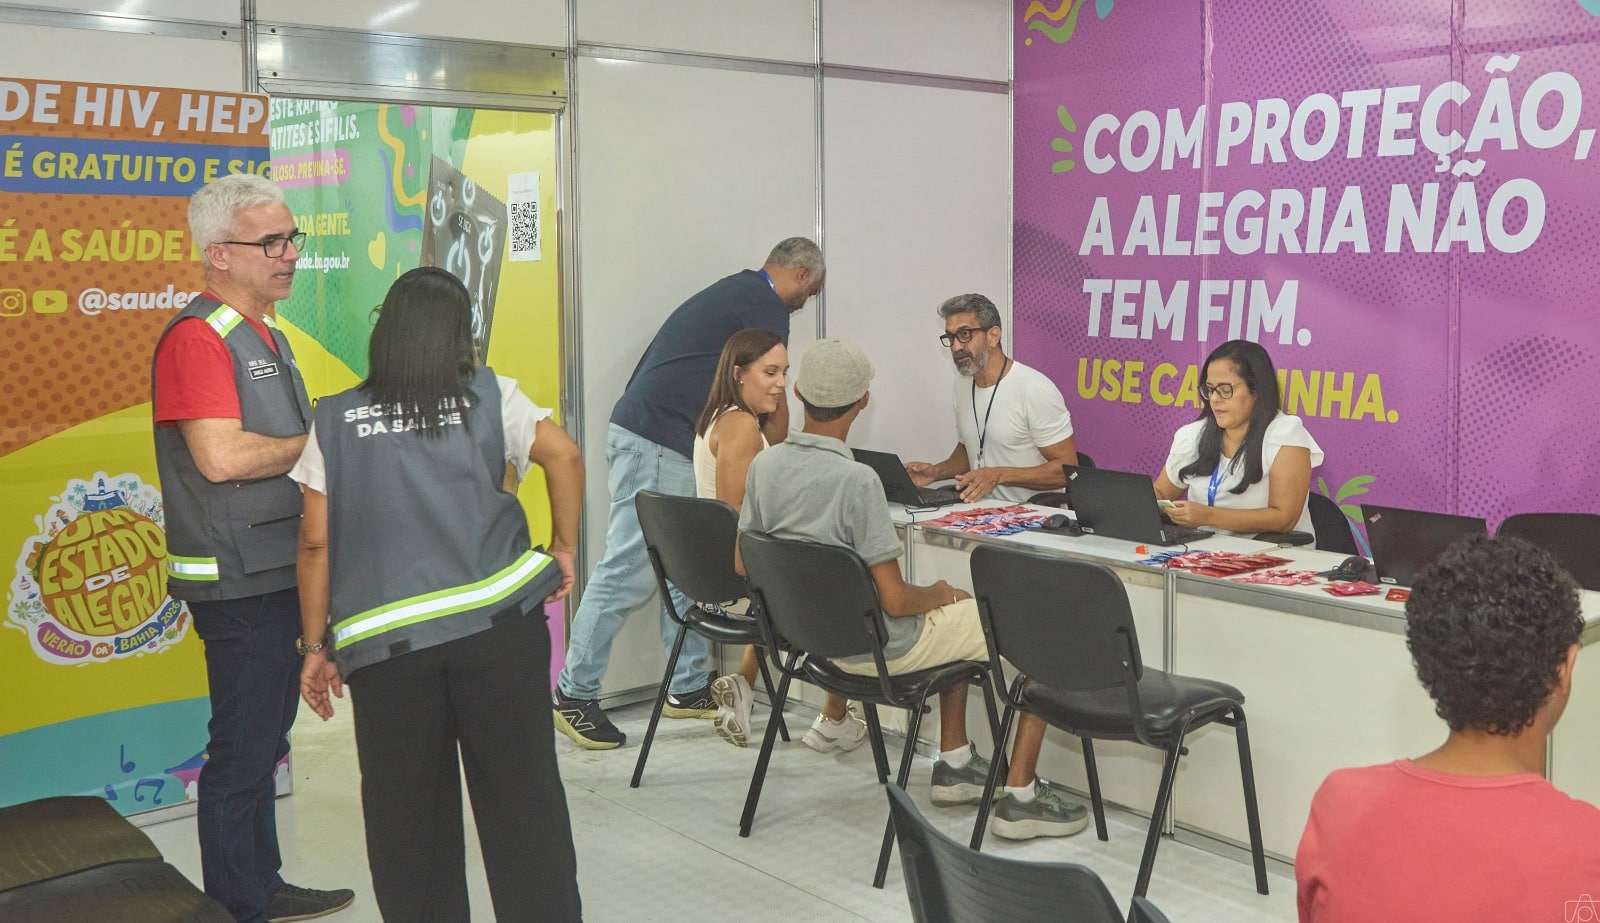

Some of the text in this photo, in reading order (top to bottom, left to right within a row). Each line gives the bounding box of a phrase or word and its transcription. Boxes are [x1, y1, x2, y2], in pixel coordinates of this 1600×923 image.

[0, 80, 61, 123] DE
[73, 86, 165, 136] HIV,
[307, 121, 314, 145] E
[1083, 53, 1596, 174] COM PROTEÇÃO,
[4, 143, 24, 178] É
[32, 151, 196, 183] GRATUITO
[203, 158, 221, 183] E
[1078, 158, 1546, 256] A ALEGRIA NÃO
[0, 218, 19, 262] É
[23, 228, 53, 262] A
[60, 220, 184, 262] SAÚDE
[78, 284, 202, 316] @saude
[1082, 279, 1312, 346] TEM FIM.
[1077, 357, 1398, 423] USE CAINHA.
[356, 421, 388, 438] DA
[41, 520, 168, 596] ESTADO
[84, 565, 131, 592] DE
[41, 601, 180, 656] VERÃO DA BAHIA 2026
